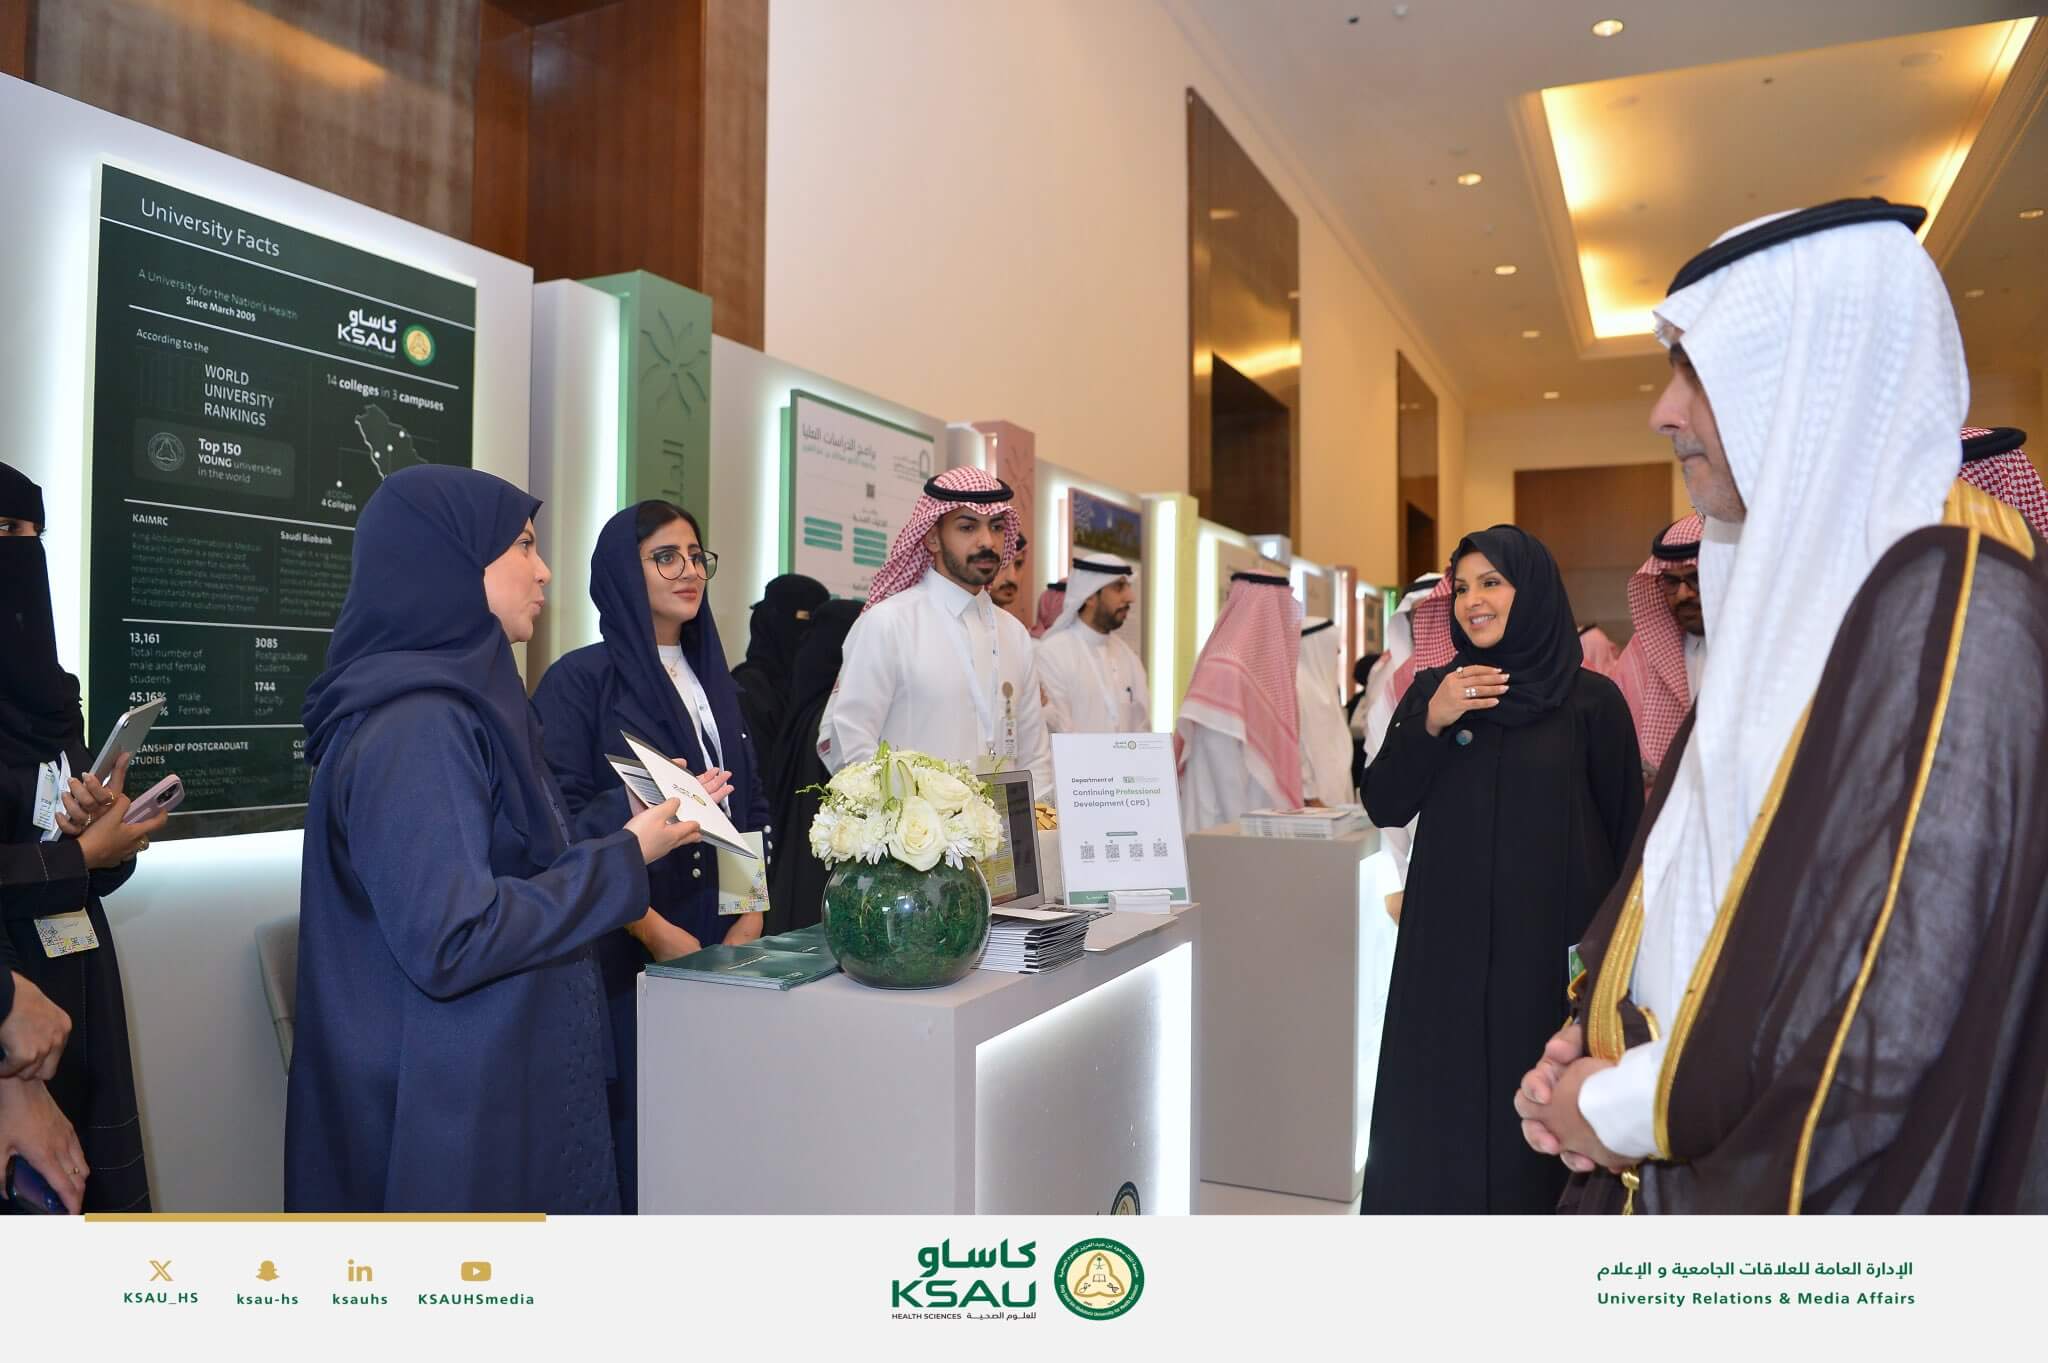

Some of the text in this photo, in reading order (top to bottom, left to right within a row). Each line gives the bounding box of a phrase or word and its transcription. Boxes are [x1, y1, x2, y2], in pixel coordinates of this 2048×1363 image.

[141, 197, 280, 257] University Facts
[138, 268, 146, 279] A
[148, 271, 197, 294] University
[197, 283, 213, 297] for
[214, 289, 230, 301] the
[186, 296, 256, 322] Since March 2005
[348, 307, 398, 334] كاساو
[136, 328, 209, 354] According to the
[336, 322, 397, 354] KSAU
[204, 363, 249, 386] WORLD
[204, 383, 275, 409] UNIVERSITY
[327, 373, 444, 411] 14 colleges in 3 campuses
[204, 402, 267, 427] RANKINGS
[198, 438, 242, 456] Top 150
[198, 453, 282, 476] YOUNG universities
[198, 467, 250, 484] in the world
[327, 498, 357, 513] Colleges
[132, 512, 169, 527] KAIMRC
[280, 530, 333, 545] Saudi Biobank
[129, 632, 160, 645] 13,161
[255, 637, 278, 649] 3085
[129, 646, 203, 658] Total number of
[129, 661, 206, 672] male and female
[129, 674, 171, 684] students
[254, 681, 276, 692] 1744
[178, 692, 201, 702] male
[178, 705, 211, 715] Female
[136, 741, 249, 753] ANSHIP OF POSTGRADUATE
[1072, 787, 1161, 797] Continuing Professional
[1073, 800, 1125, 808] Development
